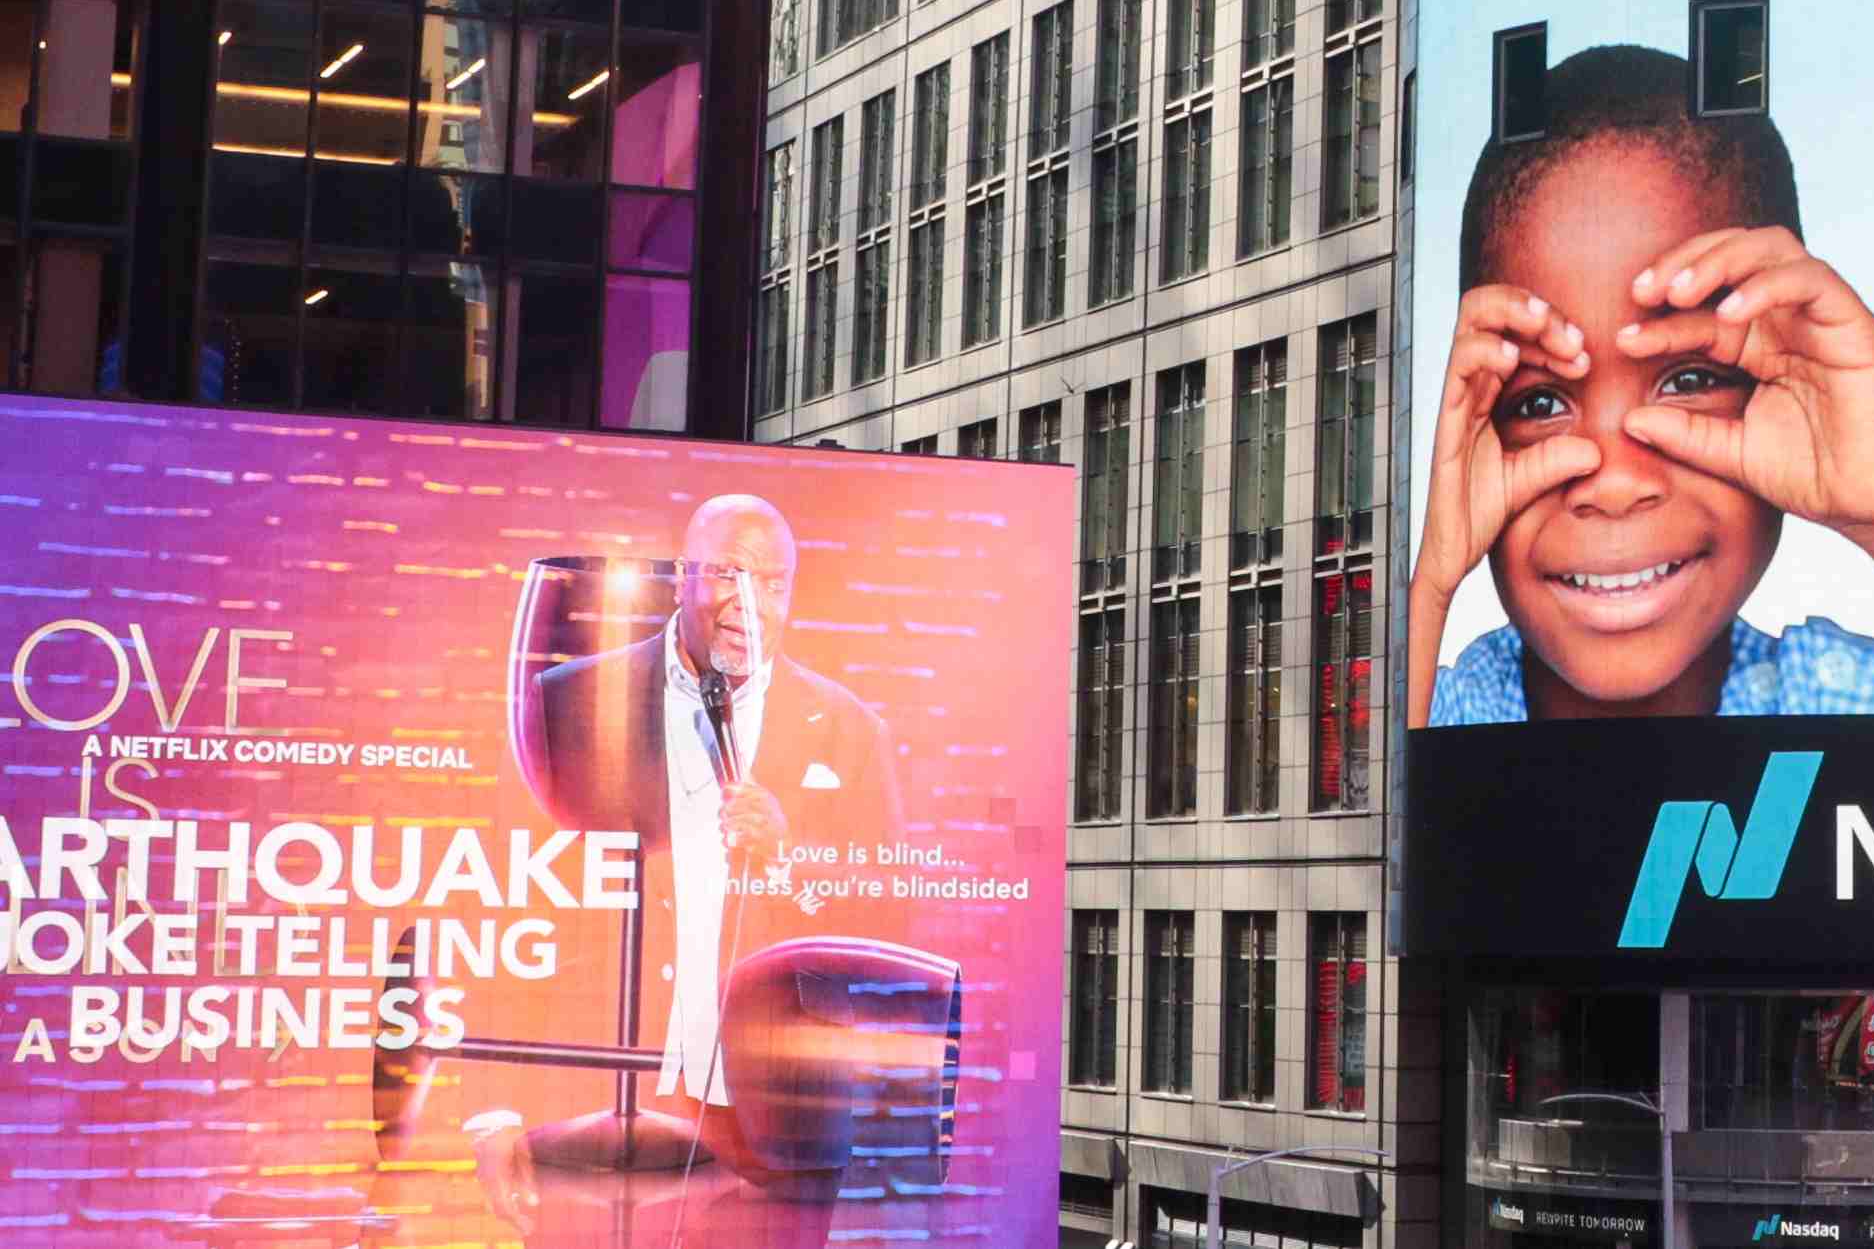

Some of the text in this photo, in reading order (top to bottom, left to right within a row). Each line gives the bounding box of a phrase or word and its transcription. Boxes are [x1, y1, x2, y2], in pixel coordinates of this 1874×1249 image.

[0, 618, 294, 736] OVE
[82, 735, 473, 769] A NETFLIX COMEDY SPECIAL
[777, 839, 838, 864] Love
[847, 841, 869, 864] is
[711, 876, 793, 897] nless
[892, 878, 1030, 901] blindsided
[226, 917, 557, 979] TELLING
[69, 986, 466, 1050] BUSINESS
[1781, 1221, 1840, 1240] Nasdaq
